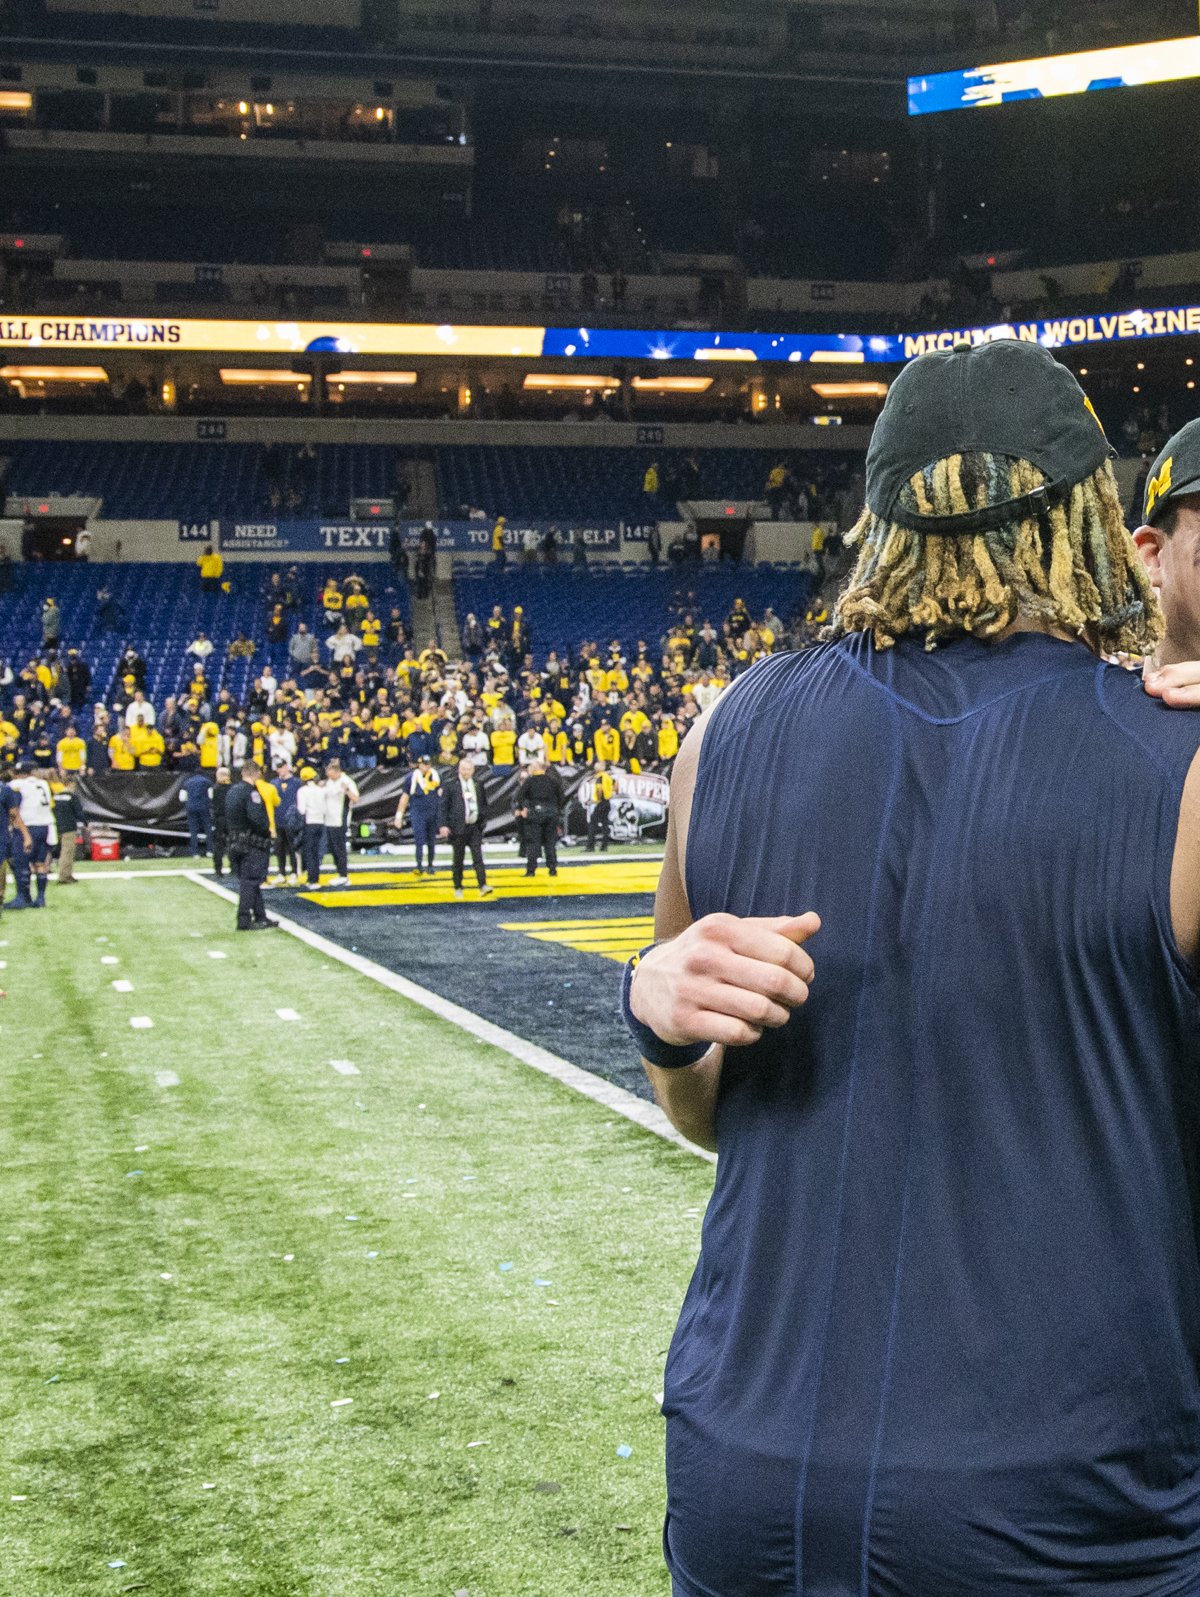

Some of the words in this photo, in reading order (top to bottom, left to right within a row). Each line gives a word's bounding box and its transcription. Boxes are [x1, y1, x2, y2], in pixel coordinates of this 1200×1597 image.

[40, 323, 181, 343] CHAMPIONS
[904, 323, 1038, 359] MICHIN
[182, 524, 209, 538] 144
[234, 524, 277, 538] NEED
[319, 525, 391, 547] TEXT
[468, 529, 489, 544] TO
[36, 784, 50, 807] 3
